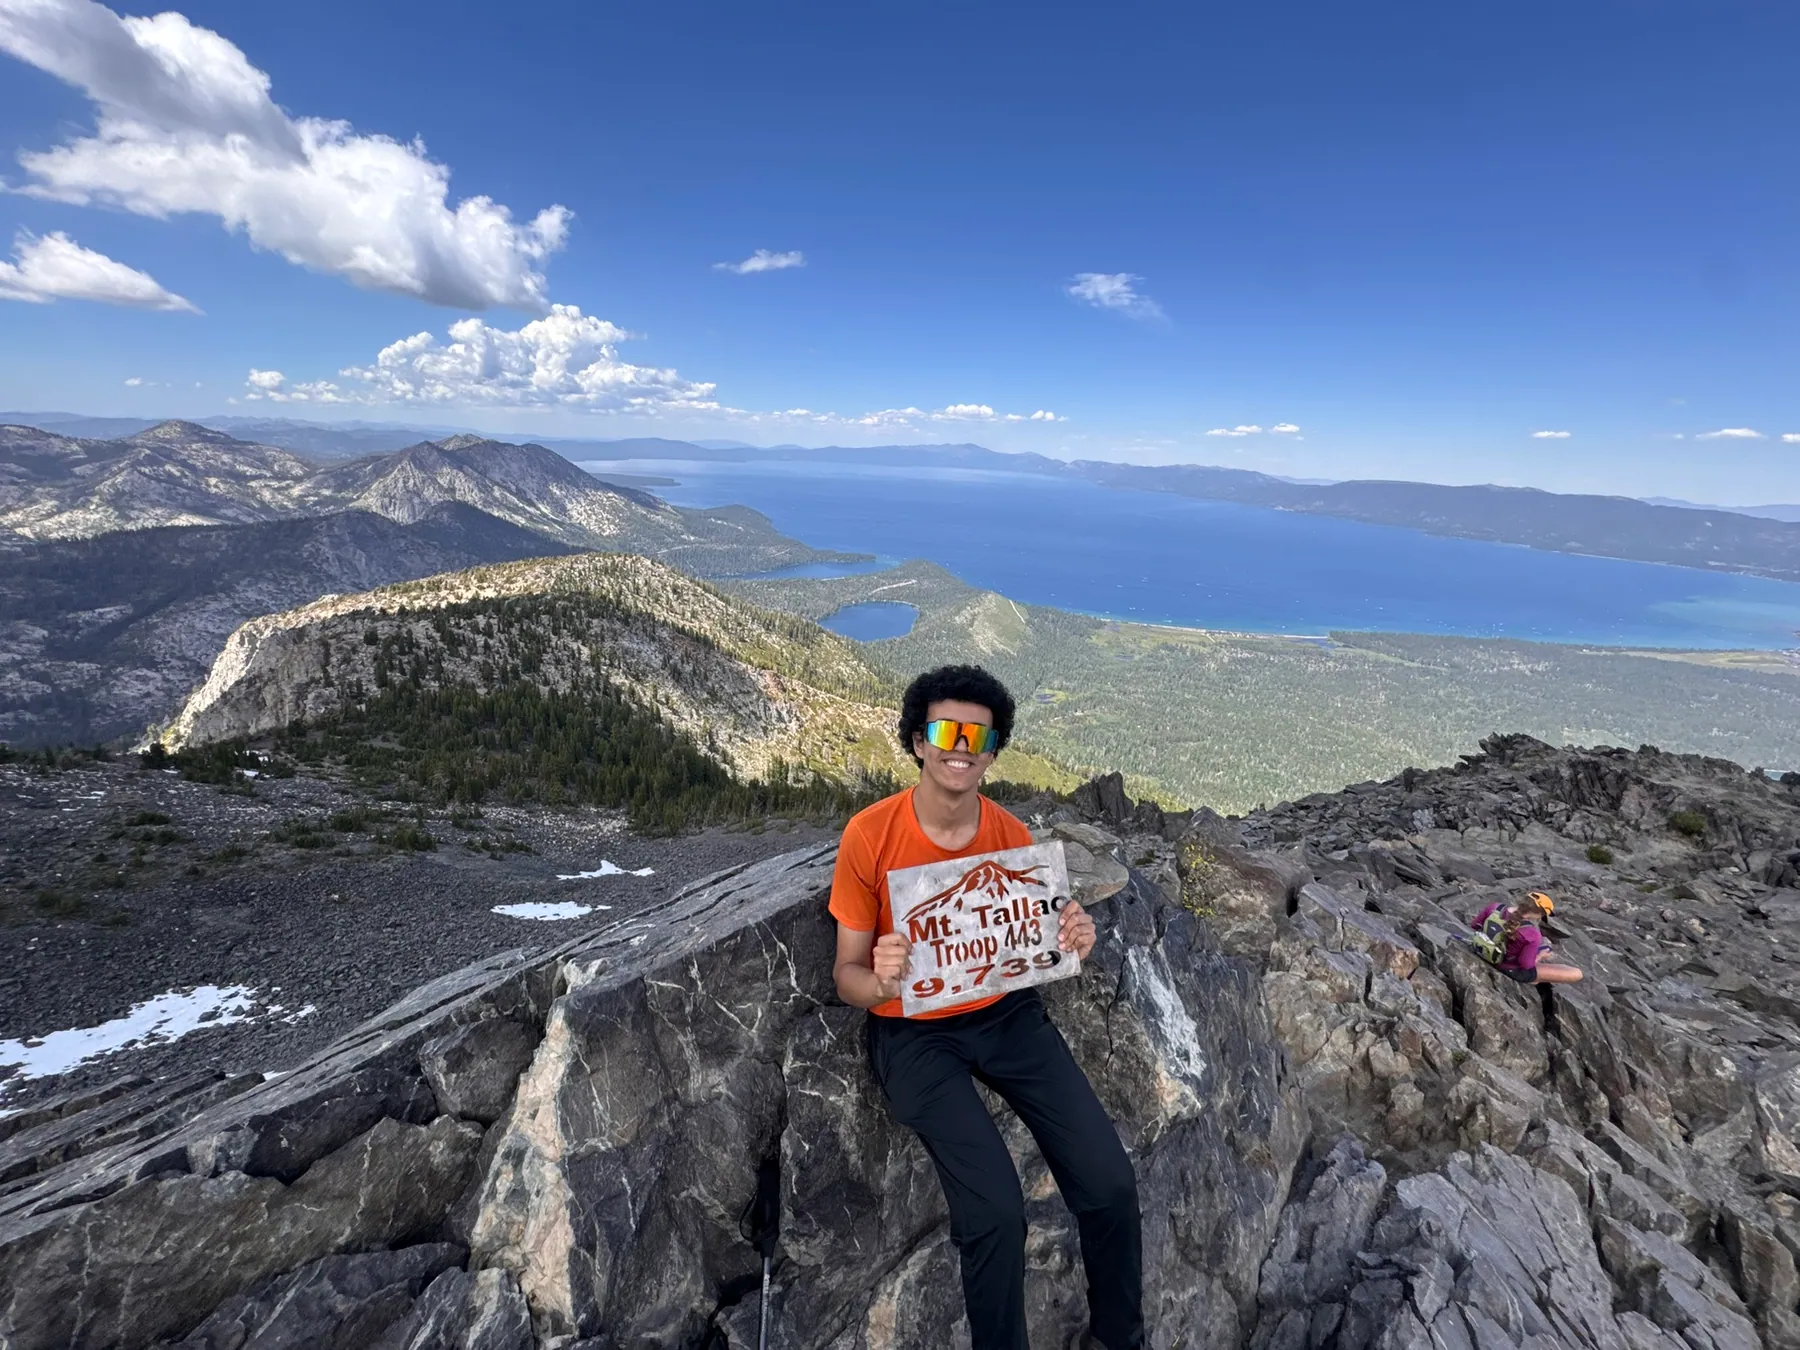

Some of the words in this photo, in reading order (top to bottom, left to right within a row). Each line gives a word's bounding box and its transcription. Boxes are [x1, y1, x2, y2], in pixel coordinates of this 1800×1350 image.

[907, 914, 961, 943] Mt.
[971, 895, 1070, 929] Tallac
[929, 935, 998, 968] Troop
[1004, 919, 1043, 950] 443
[912, 950, 1062, 998] 9,739
